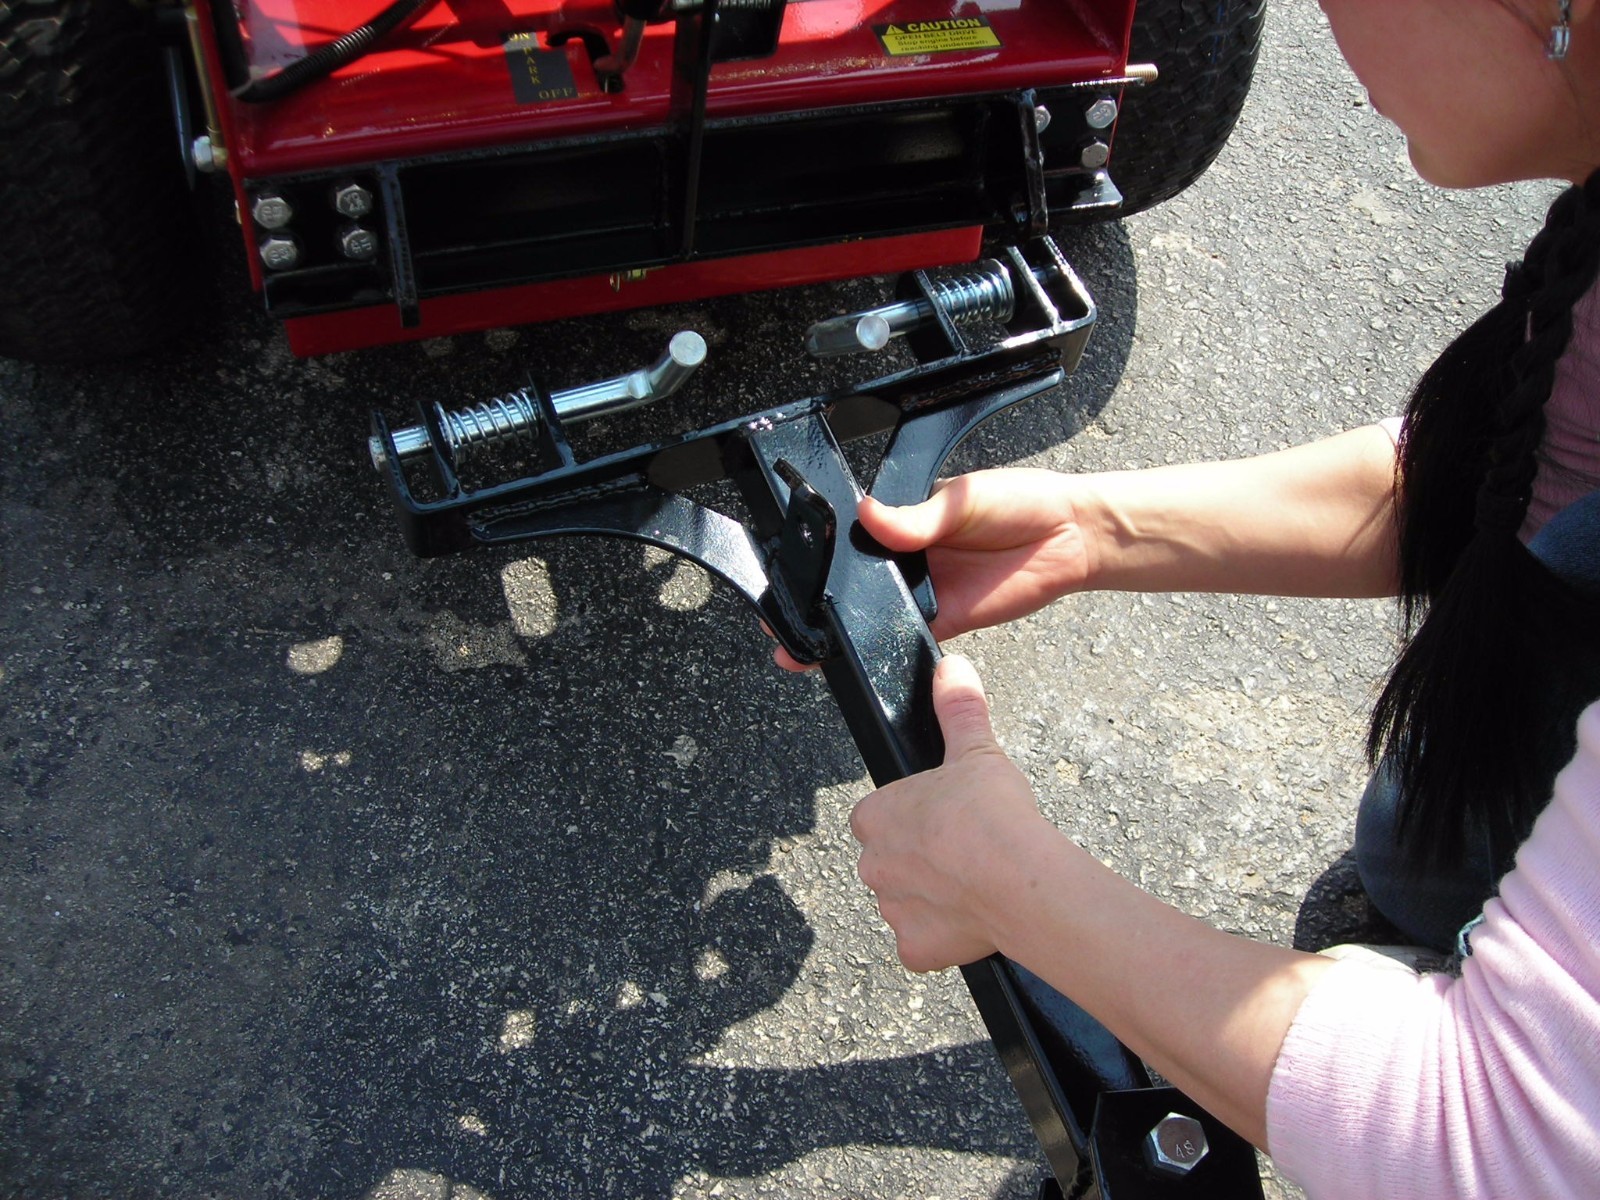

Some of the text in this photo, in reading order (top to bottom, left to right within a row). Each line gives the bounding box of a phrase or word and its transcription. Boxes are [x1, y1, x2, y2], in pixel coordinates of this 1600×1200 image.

[907, 18, 981, 32] CAUTION
[508, 32, 530, 42] ON
[894, 33, 922, 41] OPEN
[523, 46, 541, 86] PARK
[538, 88, 573, 99] OFF
